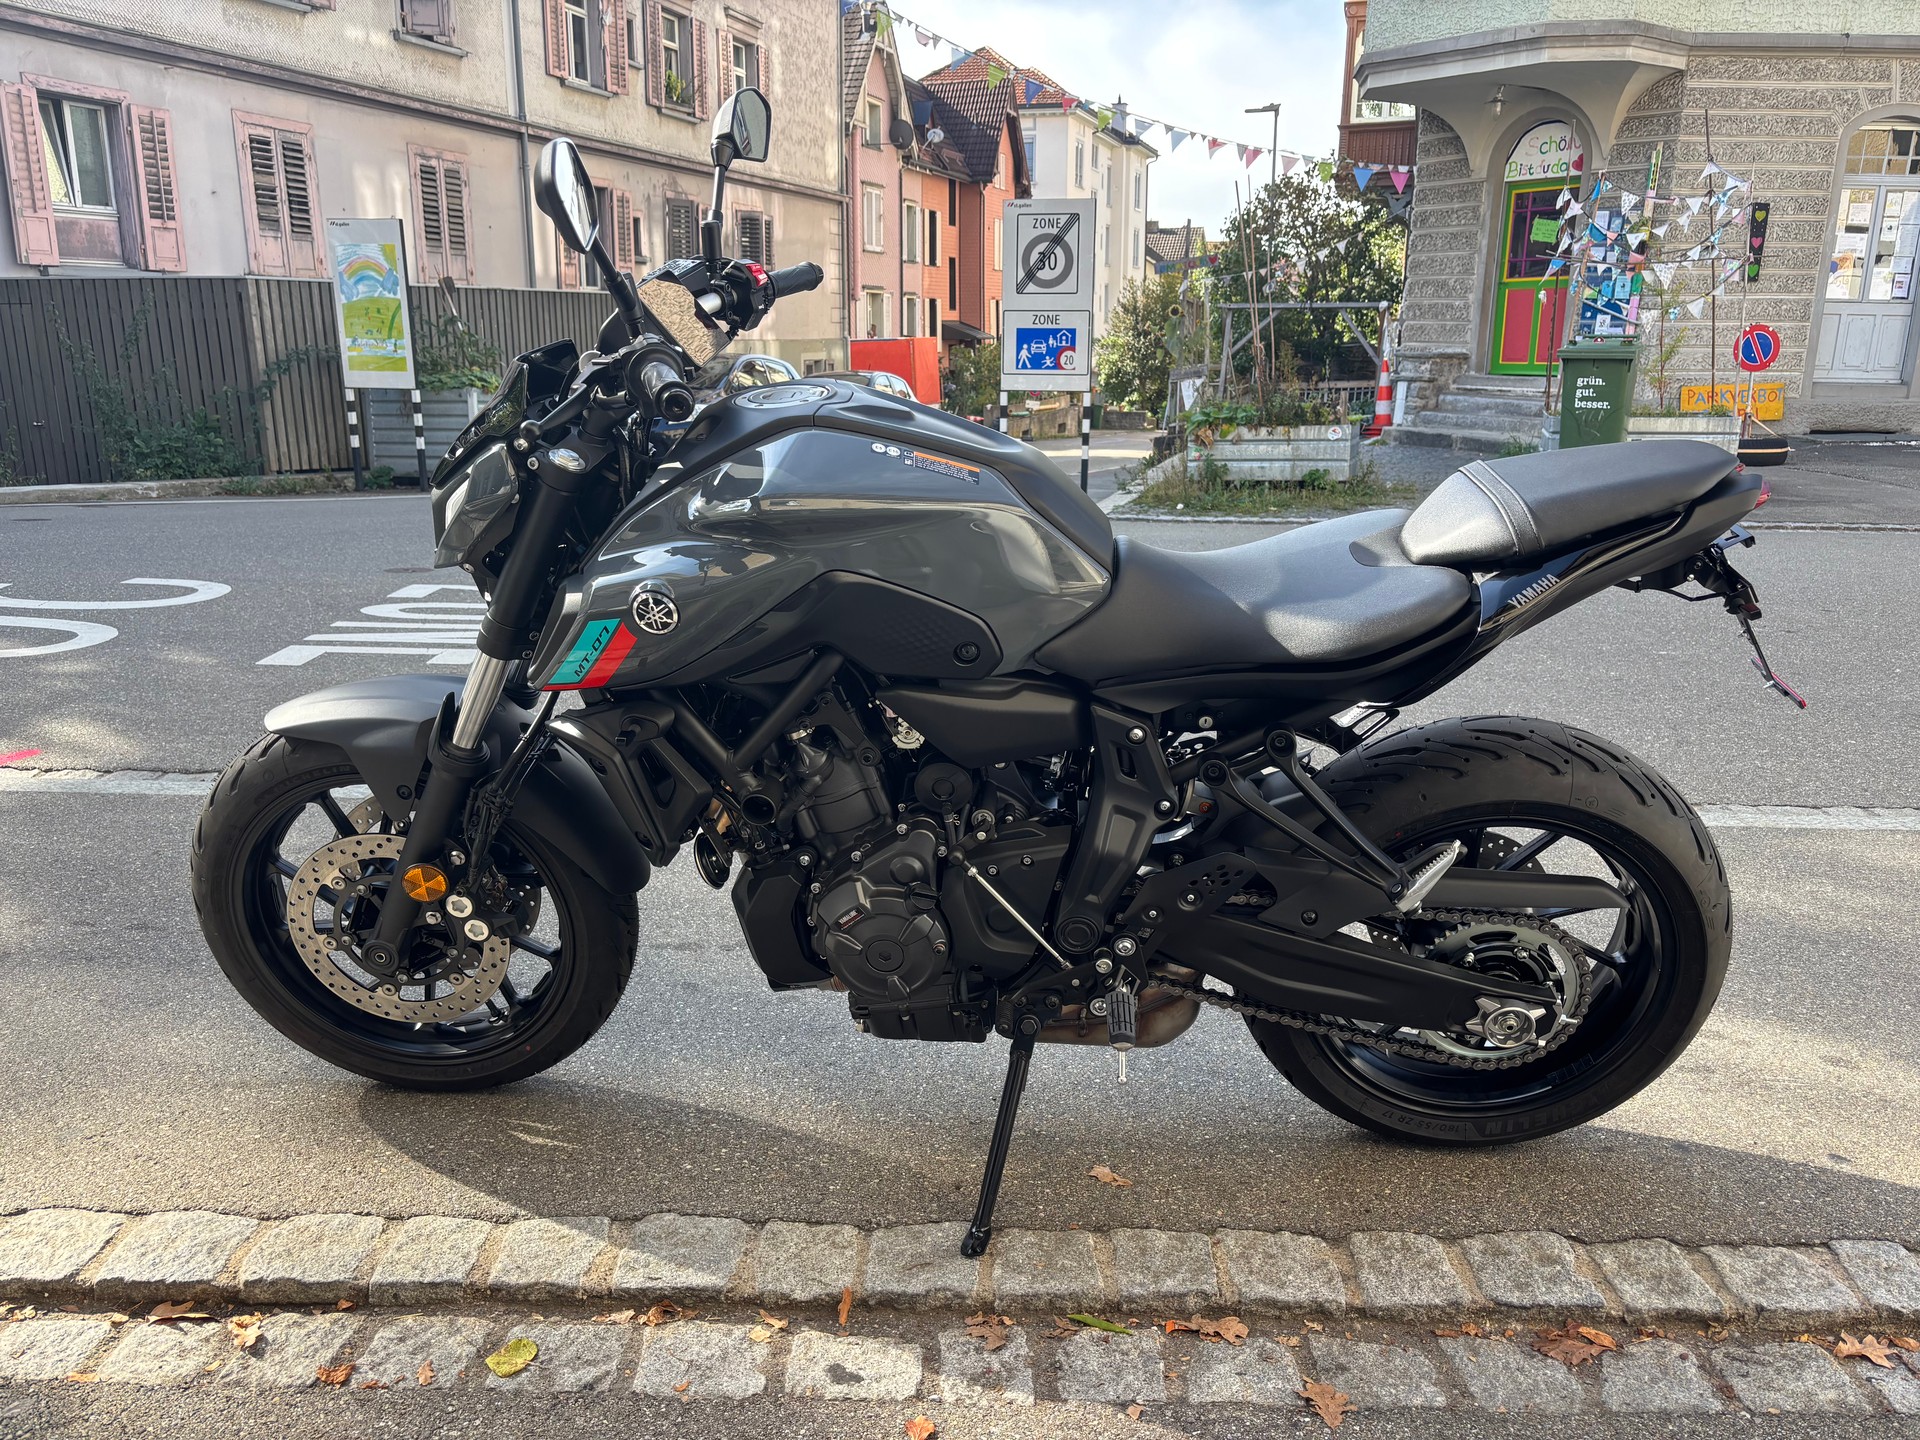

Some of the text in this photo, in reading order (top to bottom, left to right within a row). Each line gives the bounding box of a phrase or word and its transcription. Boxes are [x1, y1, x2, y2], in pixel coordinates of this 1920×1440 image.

[1032, 217, 1062, 229] ZONE
[1037, 251, 1058, 271] 30
[1032, 314, 1061, 325] ZONE
[1063, 354, 1074, 366] 20
[1576, 375, 1606, 387] grün.
[1575, 387, 1597, 399] gut.
[1574, 398, 1611, 409] besser.
[1507, 573, 1560, 609] YAMAHA
[573, 625, 611, 678] MT-07
